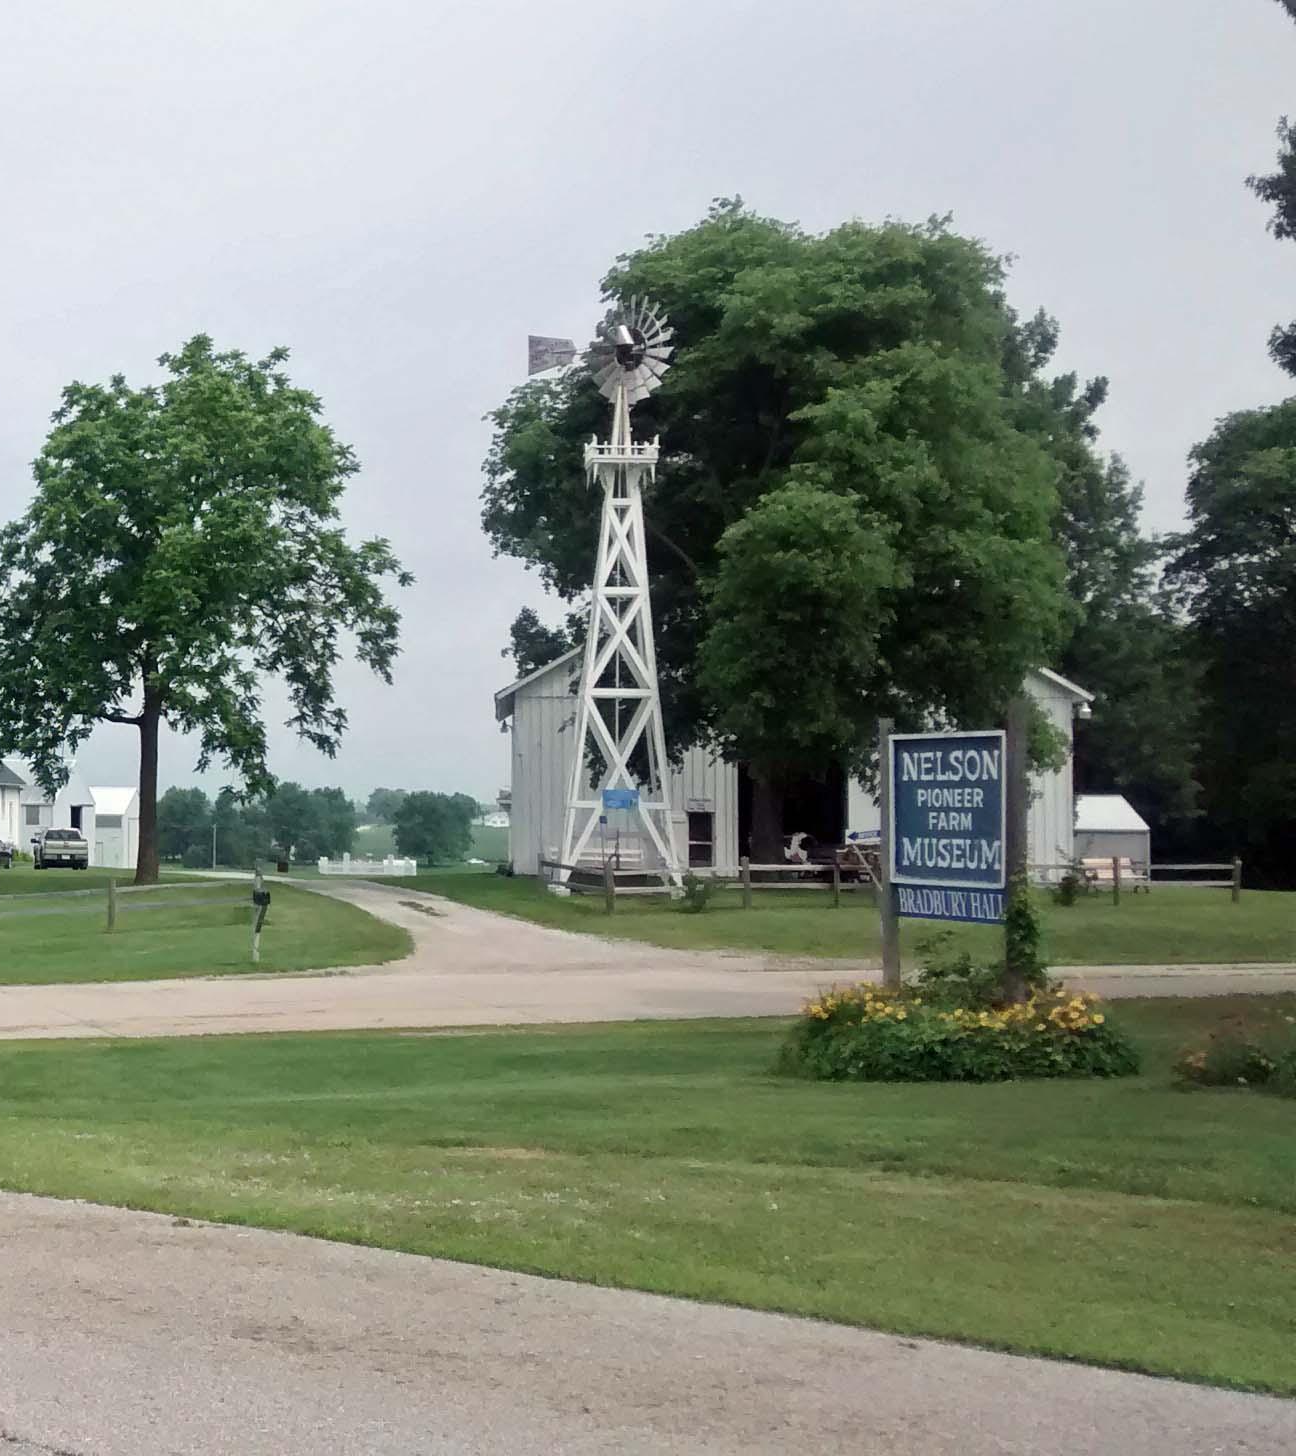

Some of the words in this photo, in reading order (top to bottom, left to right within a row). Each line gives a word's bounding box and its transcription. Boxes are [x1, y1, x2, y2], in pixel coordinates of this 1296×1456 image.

[902, 750, 1000, 781] NELSON
[917, 788, 984, 808] PIONEER
[928, 812, 973, 831] FARM
[902, 837, 1001, 870] MUSEUM
[898, 887, 968, 917] BRADBURY
[970, 893, 1006, 920] HALL
